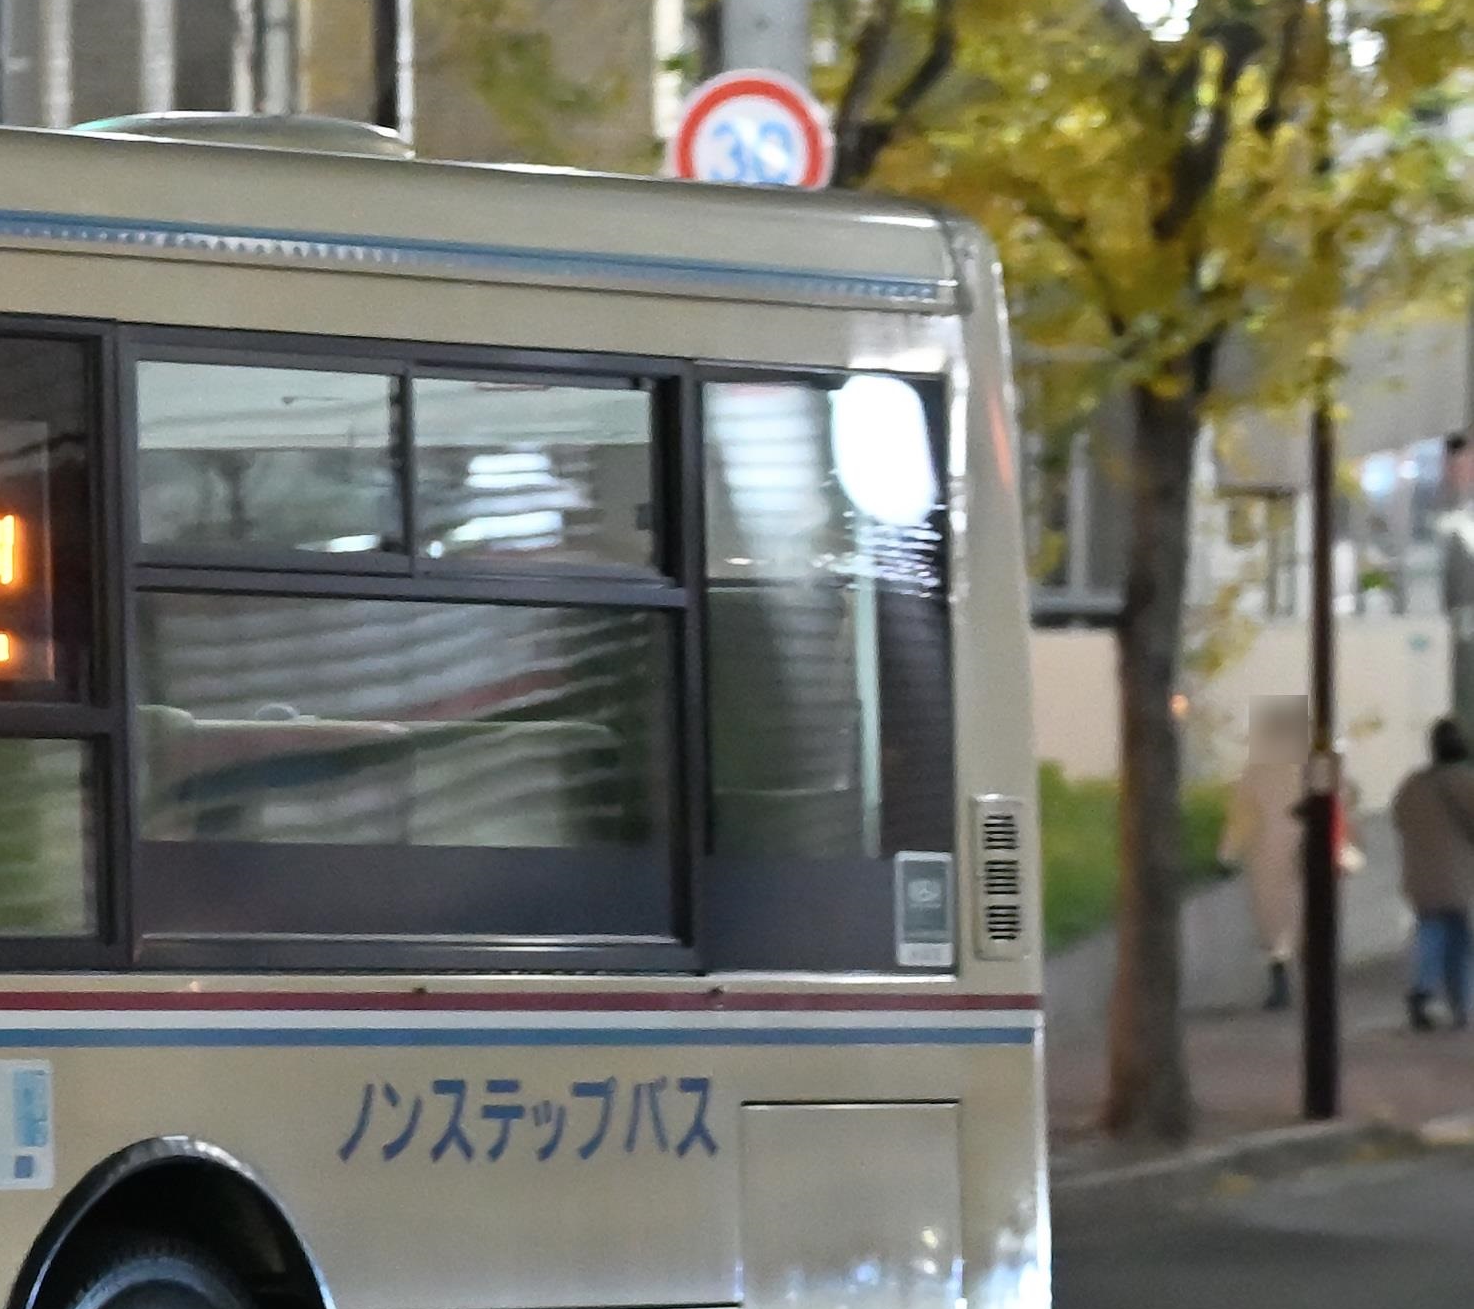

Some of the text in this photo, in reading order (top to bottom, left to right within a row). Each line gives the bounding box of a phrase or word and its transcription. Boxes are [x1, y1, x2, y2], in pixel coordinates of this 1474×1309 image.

[338, 1076, 719, 1162] ノンステップバス
